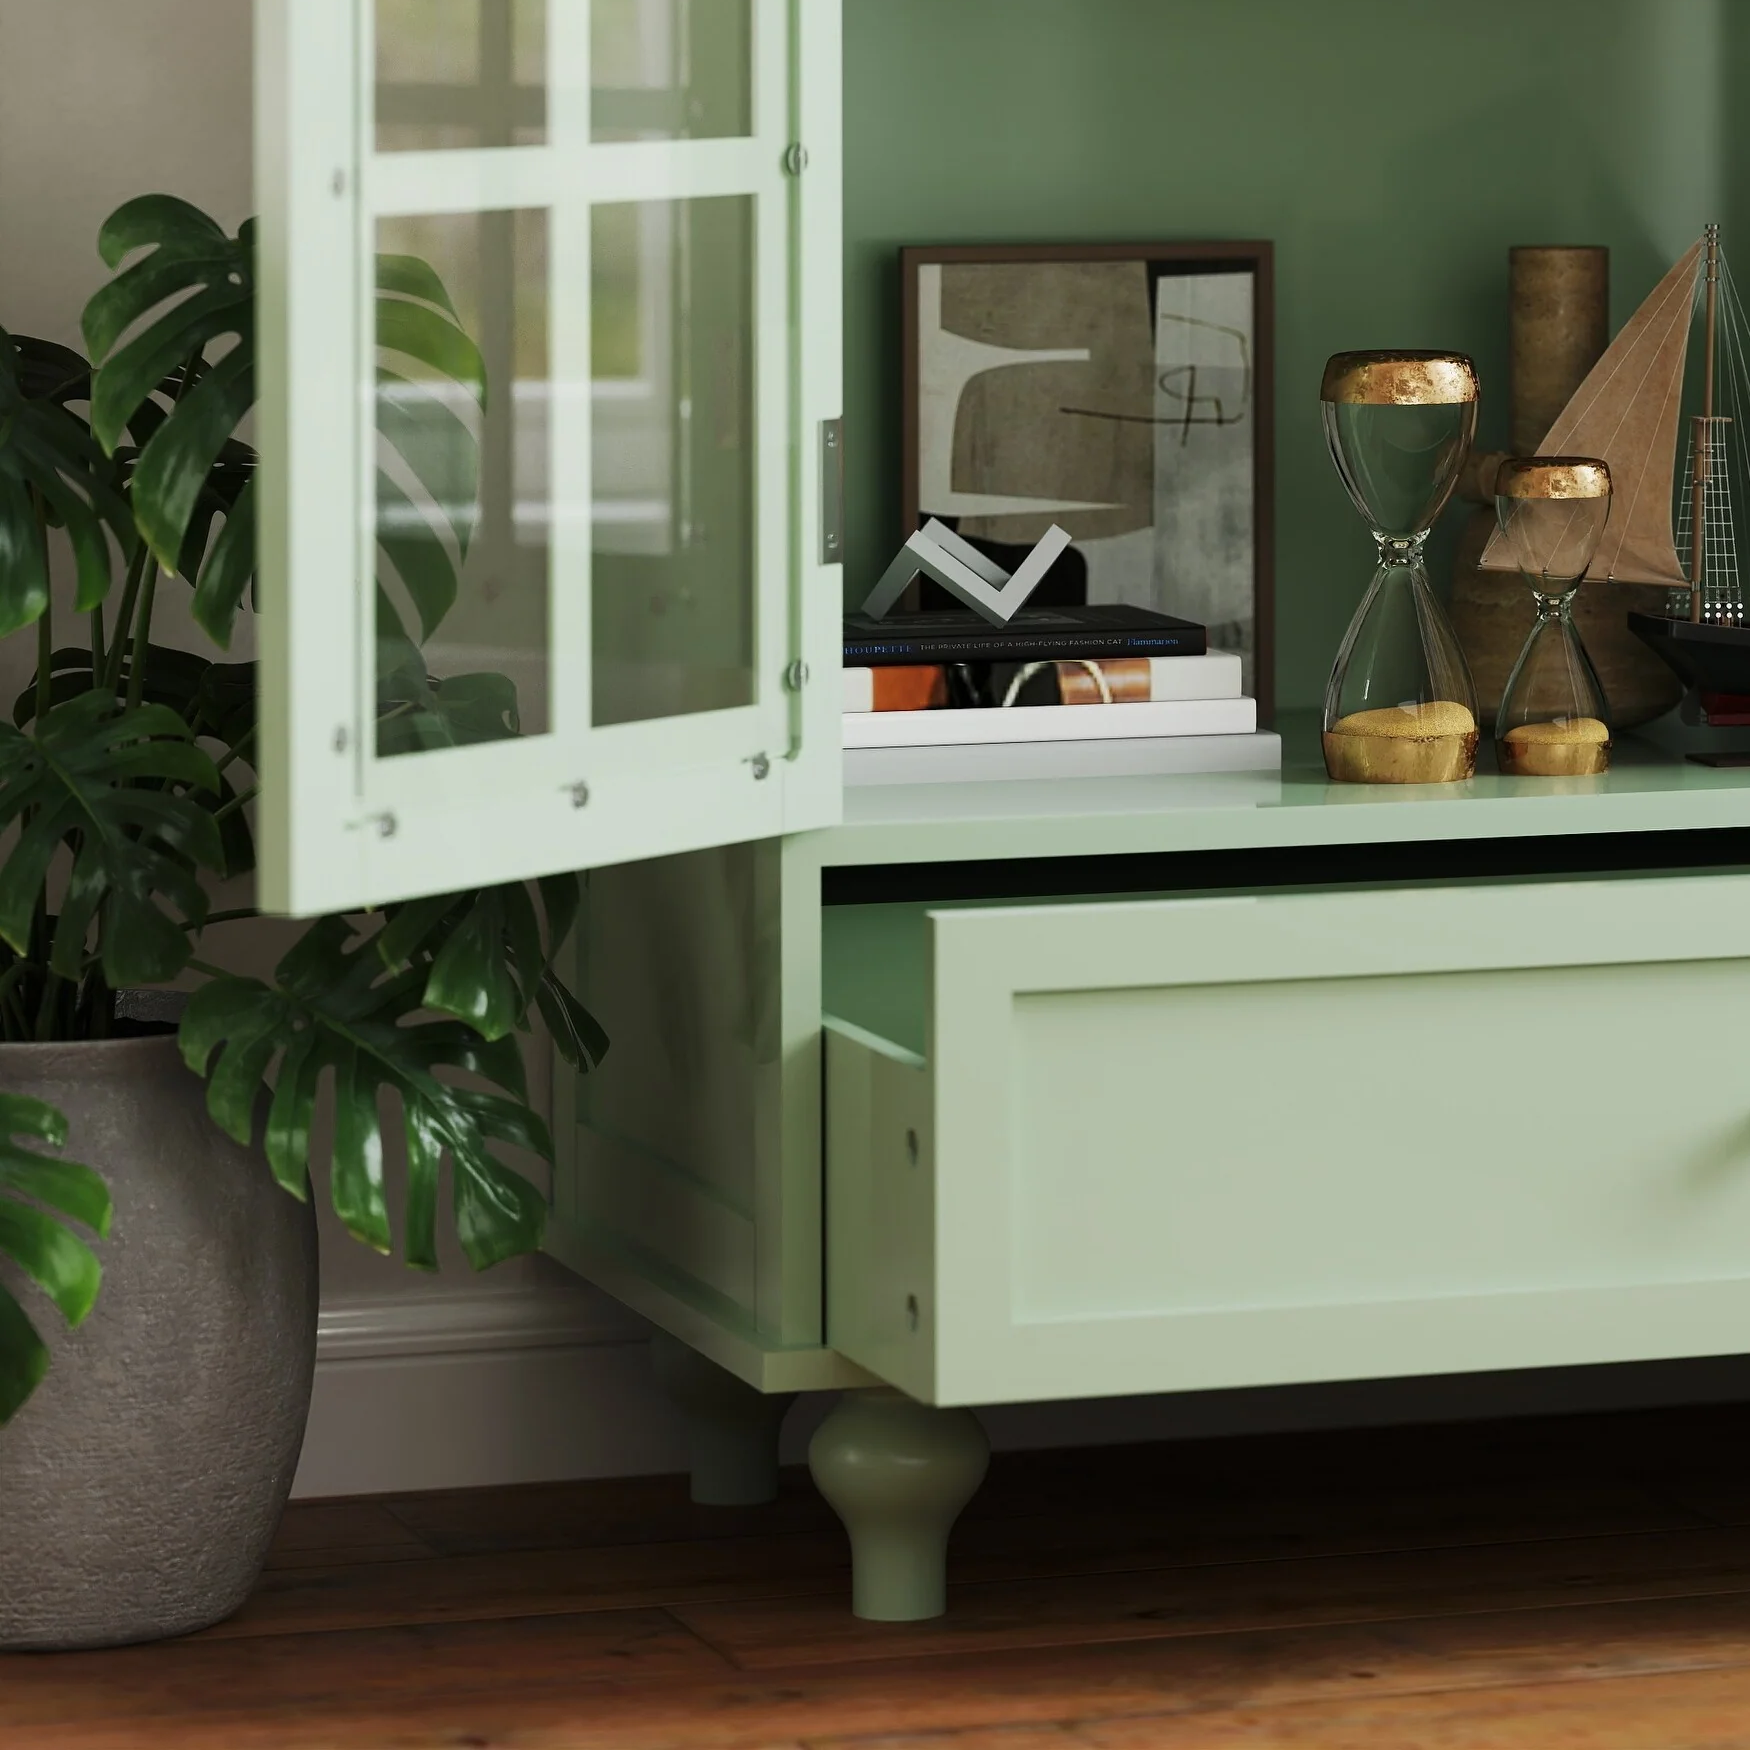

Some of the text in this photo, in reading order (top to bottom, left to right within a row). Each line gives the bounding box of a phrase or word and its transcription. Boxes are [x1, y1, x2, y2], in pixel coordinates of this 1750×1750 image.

[844, 644, 913, 655] HOUPETTE
[938, 642, 972, 650] PRIVATE
[1127, 638, 1178, 646] Flammarion
